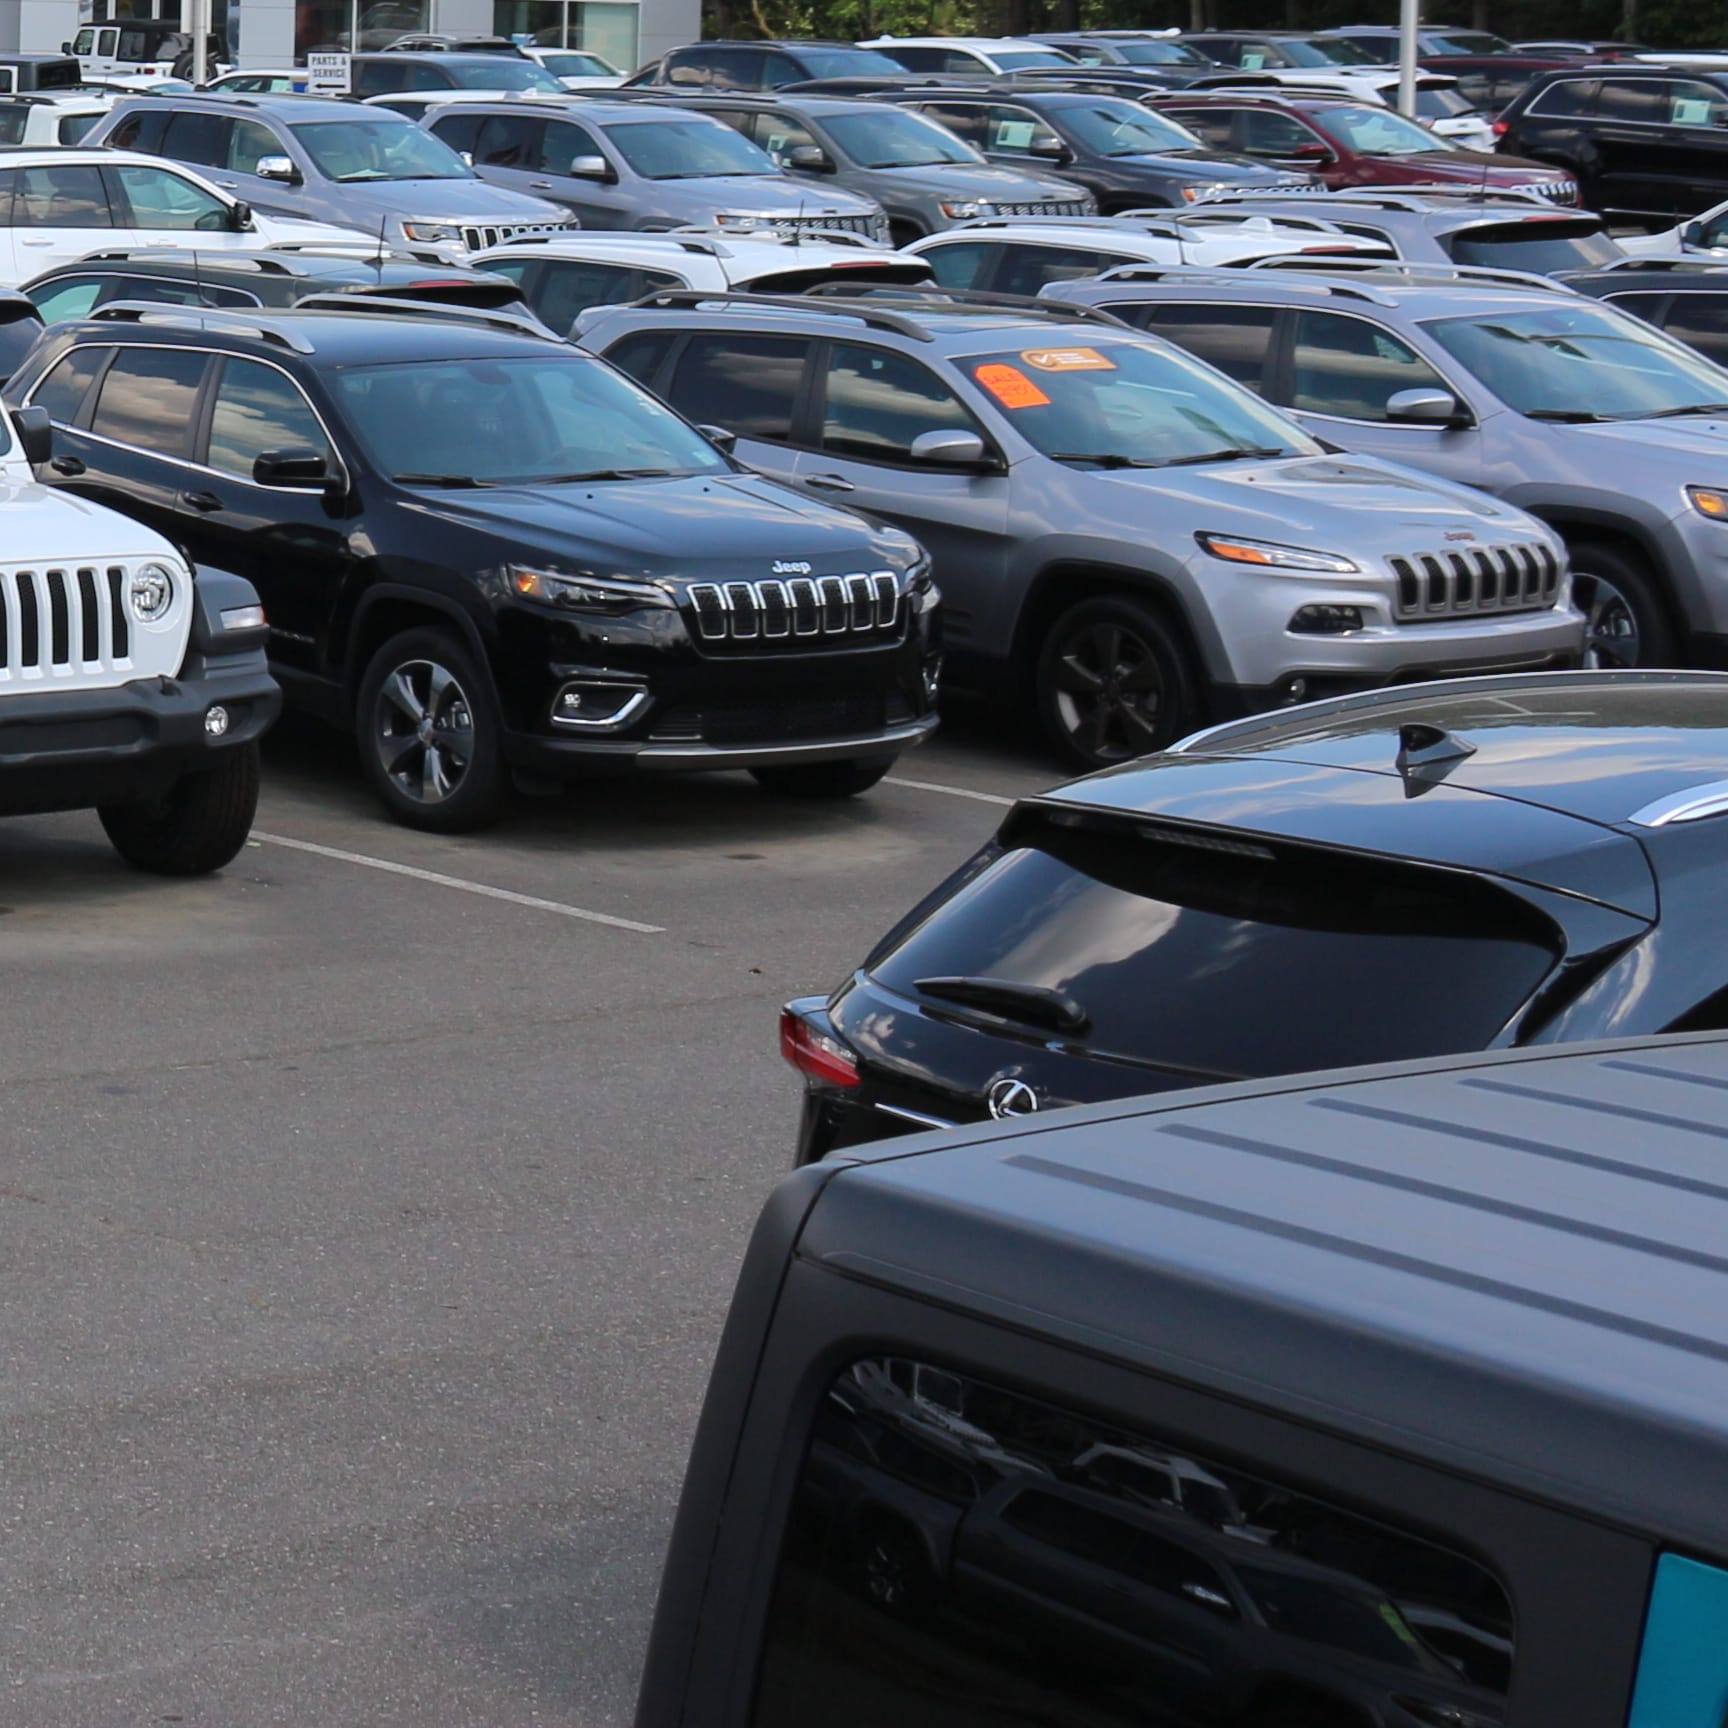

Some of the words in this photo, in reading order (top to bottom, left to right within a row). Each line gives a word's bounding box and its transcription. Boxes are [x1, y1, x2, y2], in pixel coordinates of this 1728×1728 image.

[312, 56, 337, 66] PARTS
[313, 68, 346, 78] SERVICE
[772, 559, 812, 574] Jeep
